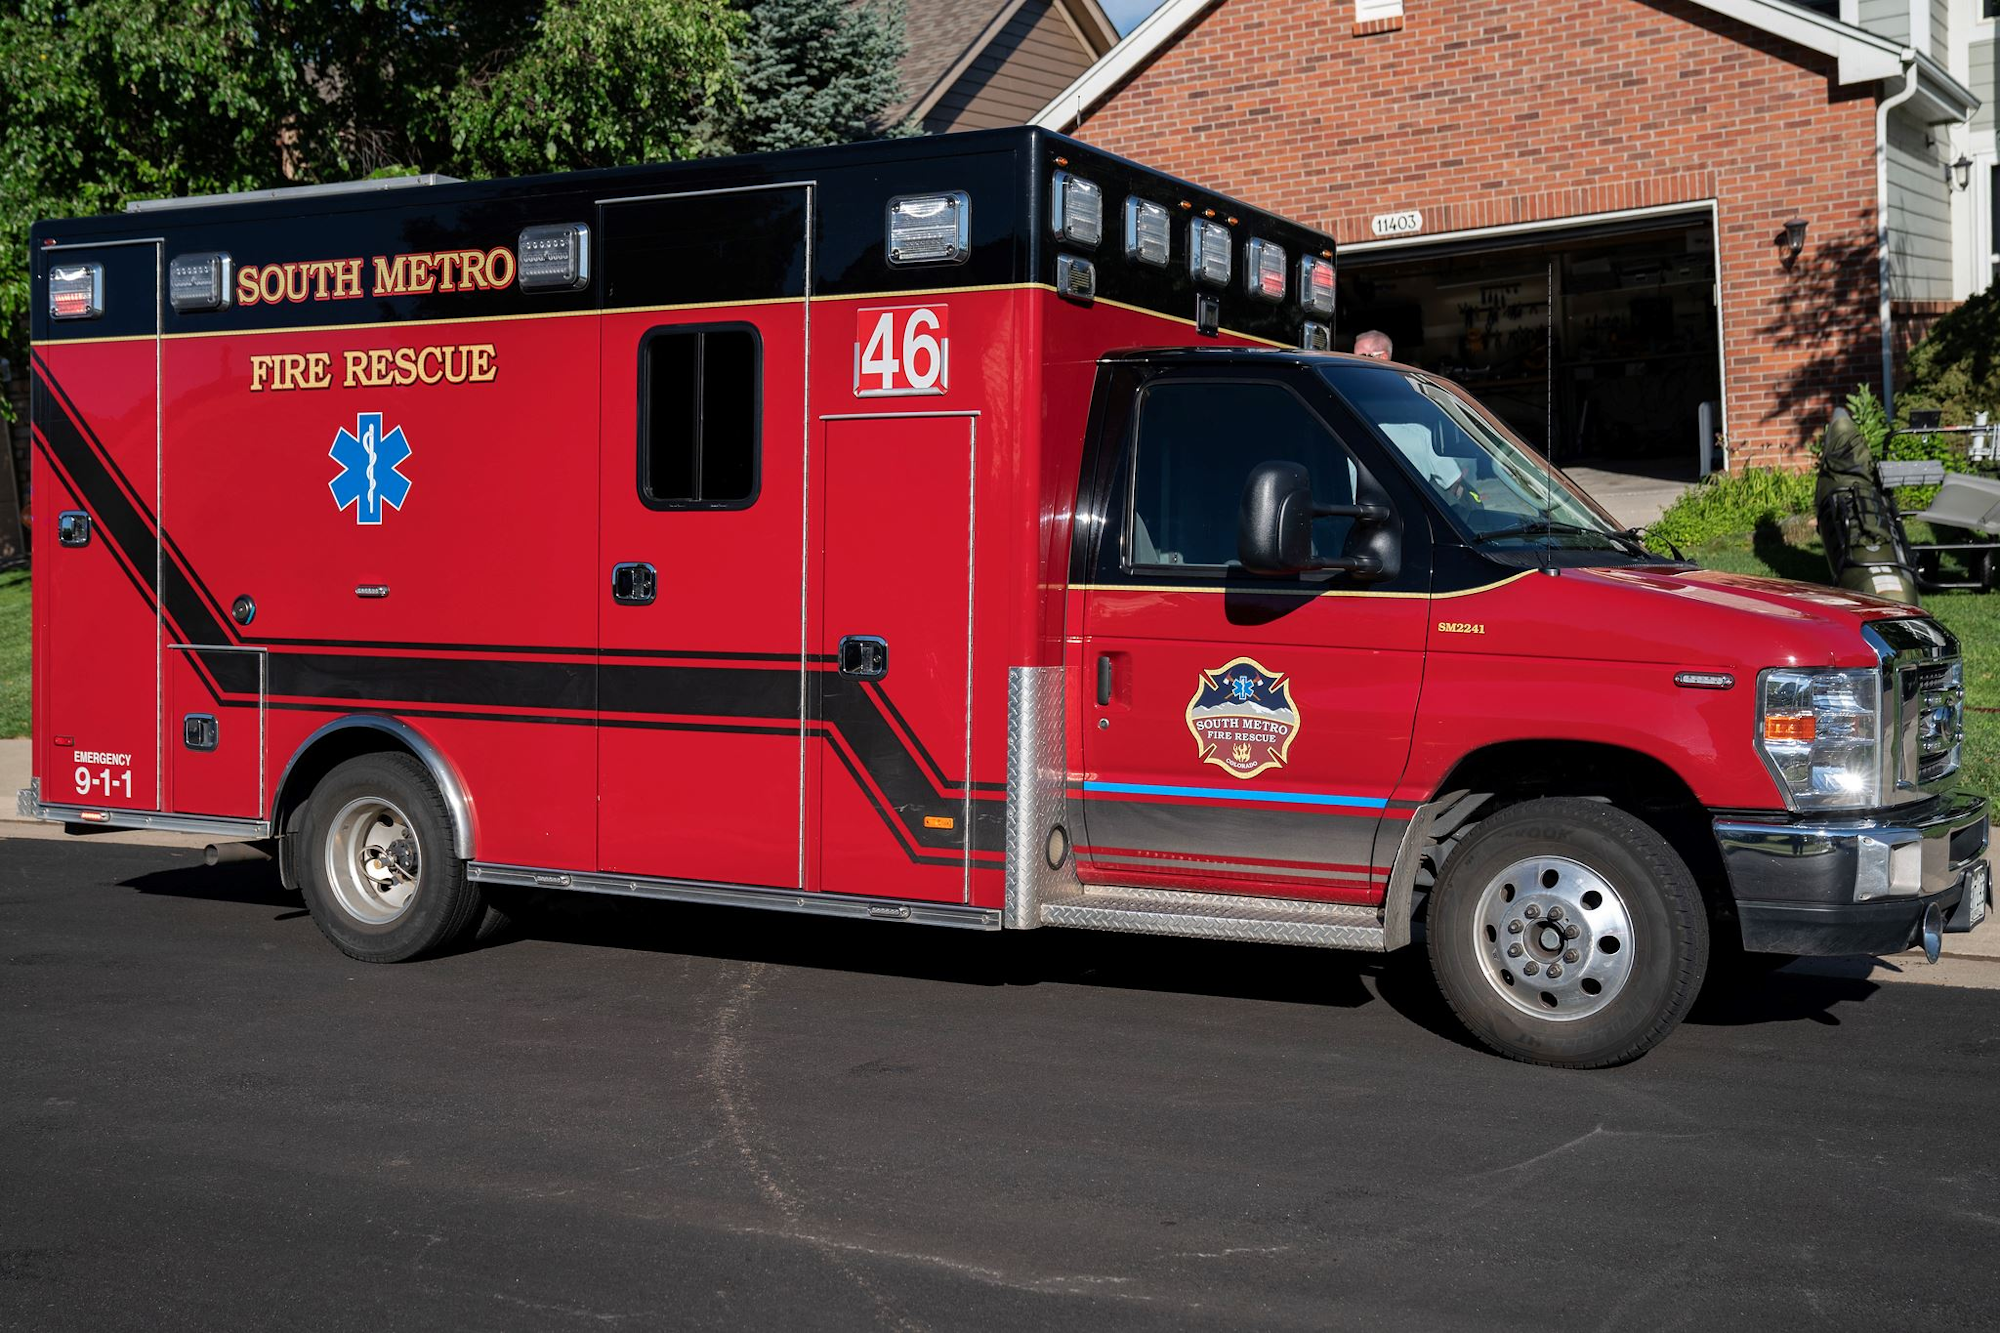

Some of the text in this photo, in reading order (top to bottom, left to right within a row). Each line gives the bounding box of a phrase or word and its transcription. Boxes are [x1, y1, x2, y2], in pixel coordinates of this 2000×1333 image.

[1377, 215, 1416, 232] 11403
[237, 247, 516, 306] SOUTH METRO
[861, 308, 940, 390] 46
[250, 344, 498, 392] FIRE RESCUE
[1437, 621, 1486, 634] SM2241
[1196, 718, 1288, 735] SOUTH METRO
[1207, 730, 1277, 743] FIRE RESCUE
[74, 750, 132, 766] EMERGENCY
[1225, 758, 1258, 769] COLORADO
[75, 766, 132, 798] 9-1-1
